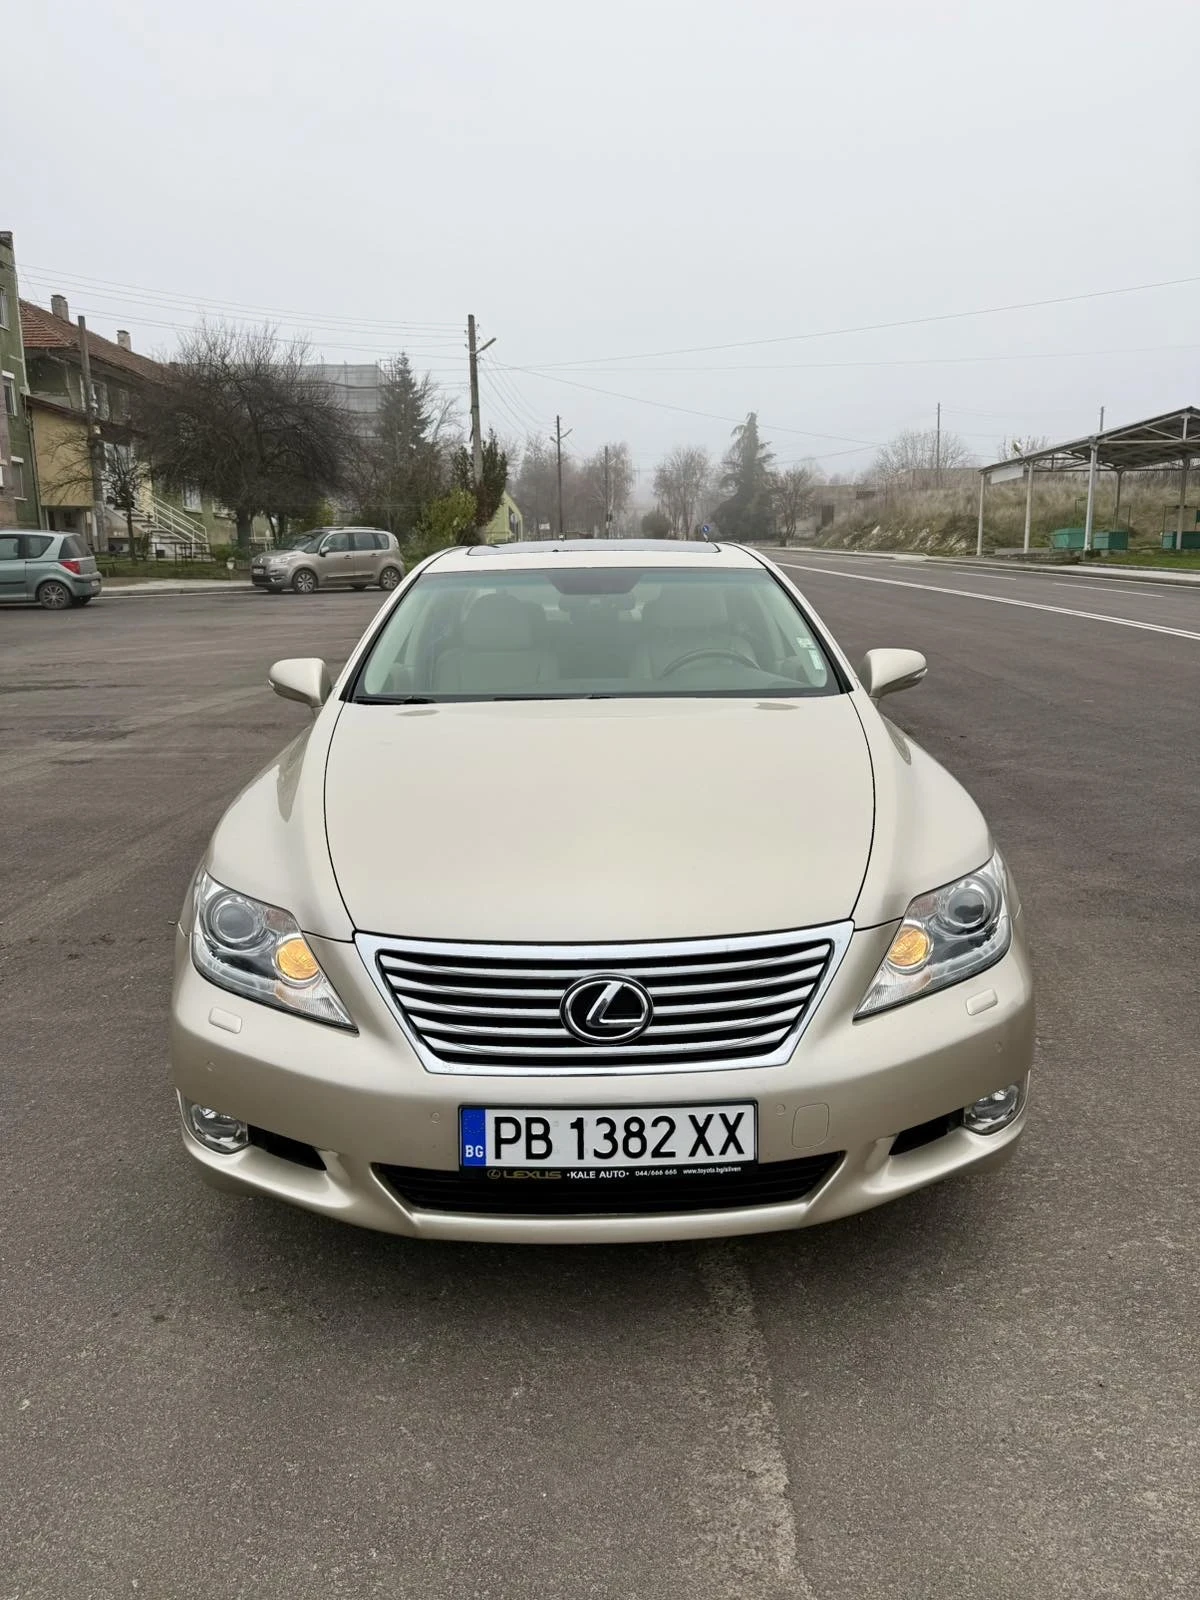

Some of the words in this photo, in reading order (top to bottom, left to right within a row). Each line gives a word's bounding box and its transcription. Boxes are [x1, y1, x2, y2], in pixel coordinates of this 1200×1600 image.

[494, 1116, 553, 1160] PB
[570, 1116, 677, 1160] 1382
[688, 1112, 745, 1158] XX
[465, 1145, 484, 1158] BG
[503, 1170, 562, 1179] LEXUS
